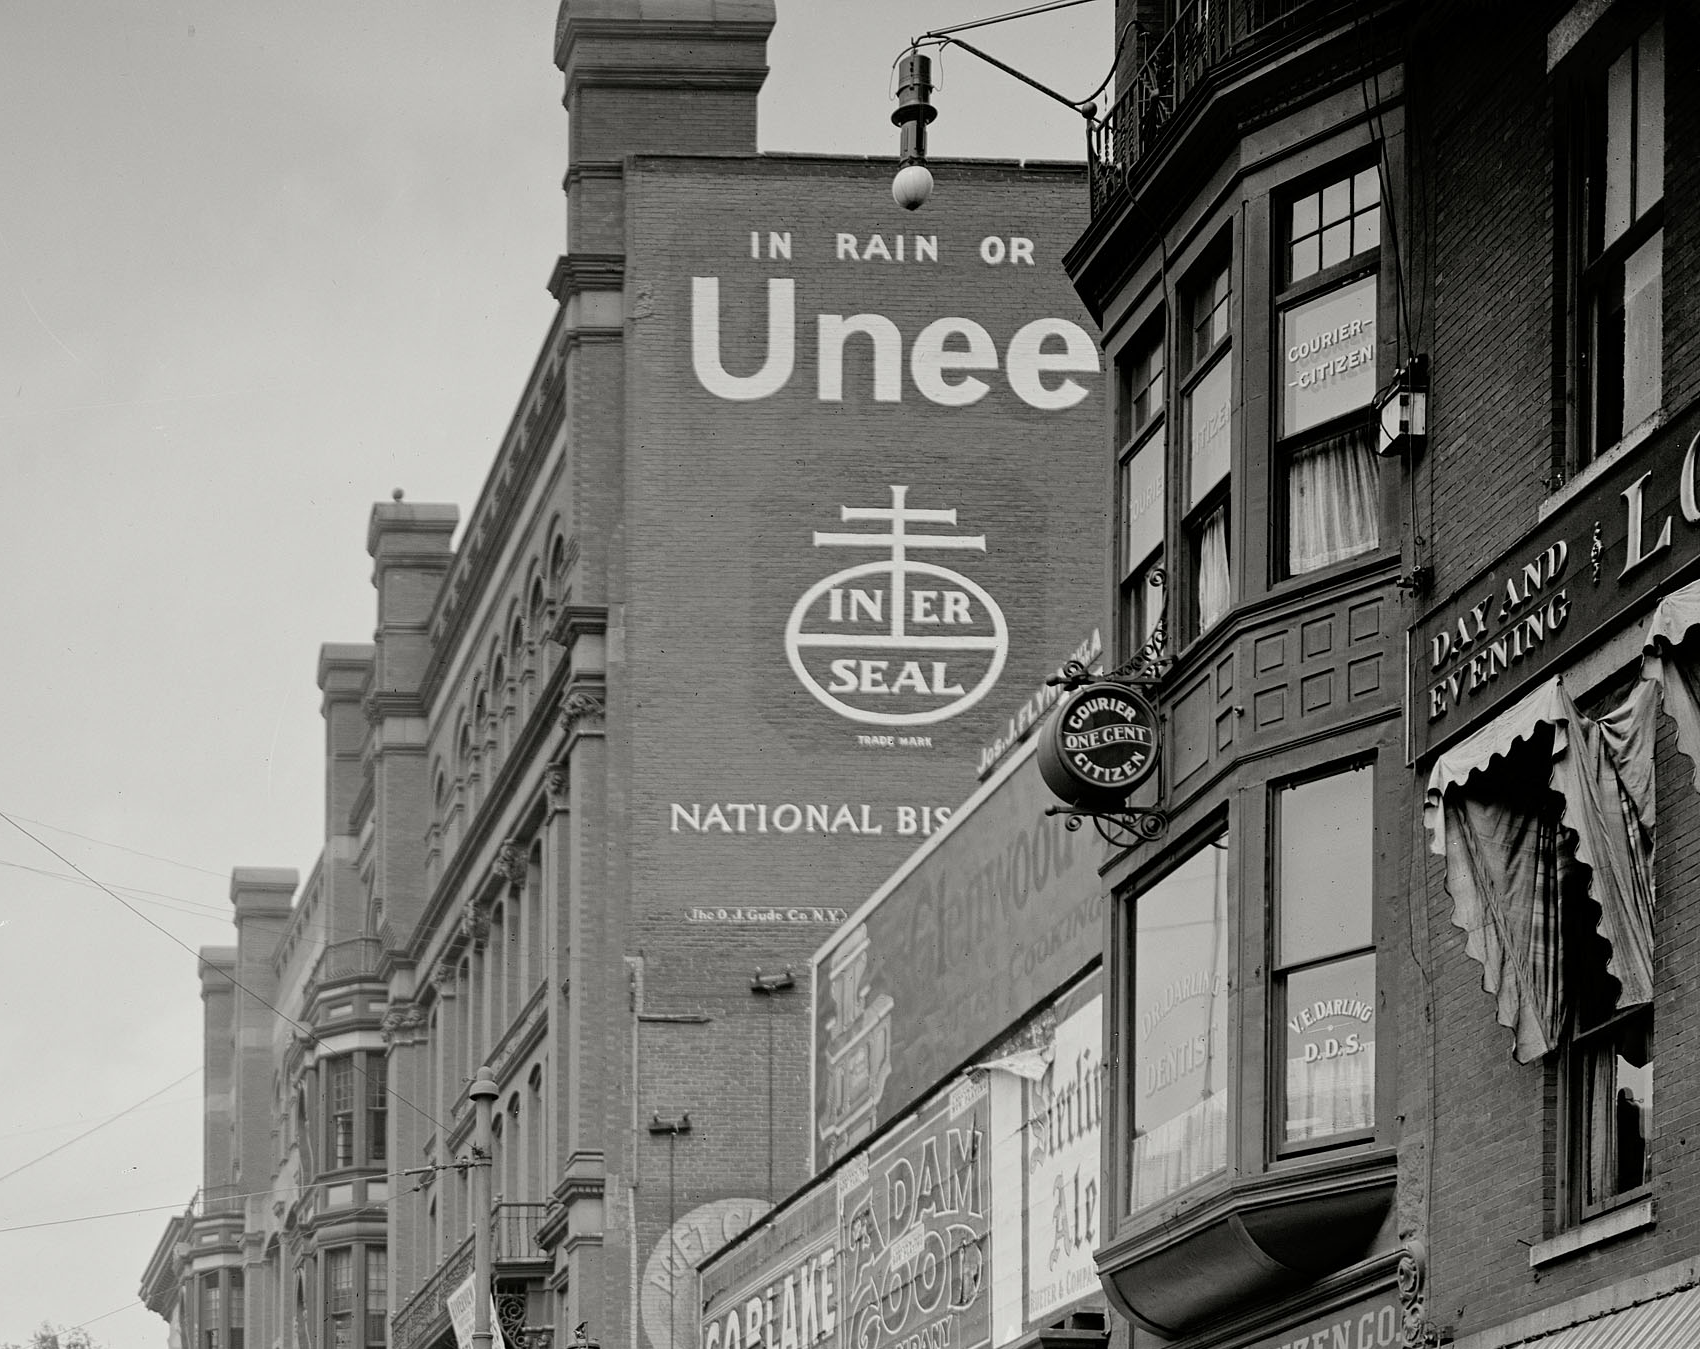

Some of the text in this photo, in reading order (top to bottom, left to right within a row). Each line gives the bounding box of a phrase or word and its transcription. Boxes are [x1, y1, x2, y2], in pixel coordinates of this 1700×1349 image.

[750, 231, 1036, 265] IN RAIN OR
[1431, 540, 1569, 673] DAY AND
[1428, 589, 1573, 724] EVENING
[828, 658, 966, 695] SEAL
[1068, 696, 1138, 730] COURIER
[857, 735, 933, 748] TRADE MARK
[1066, 726, 1148, 749] ONE CENT
[1073, 750, 1146, 782] CITIZEN
[670, 803, 883, 835] NATIONAL
